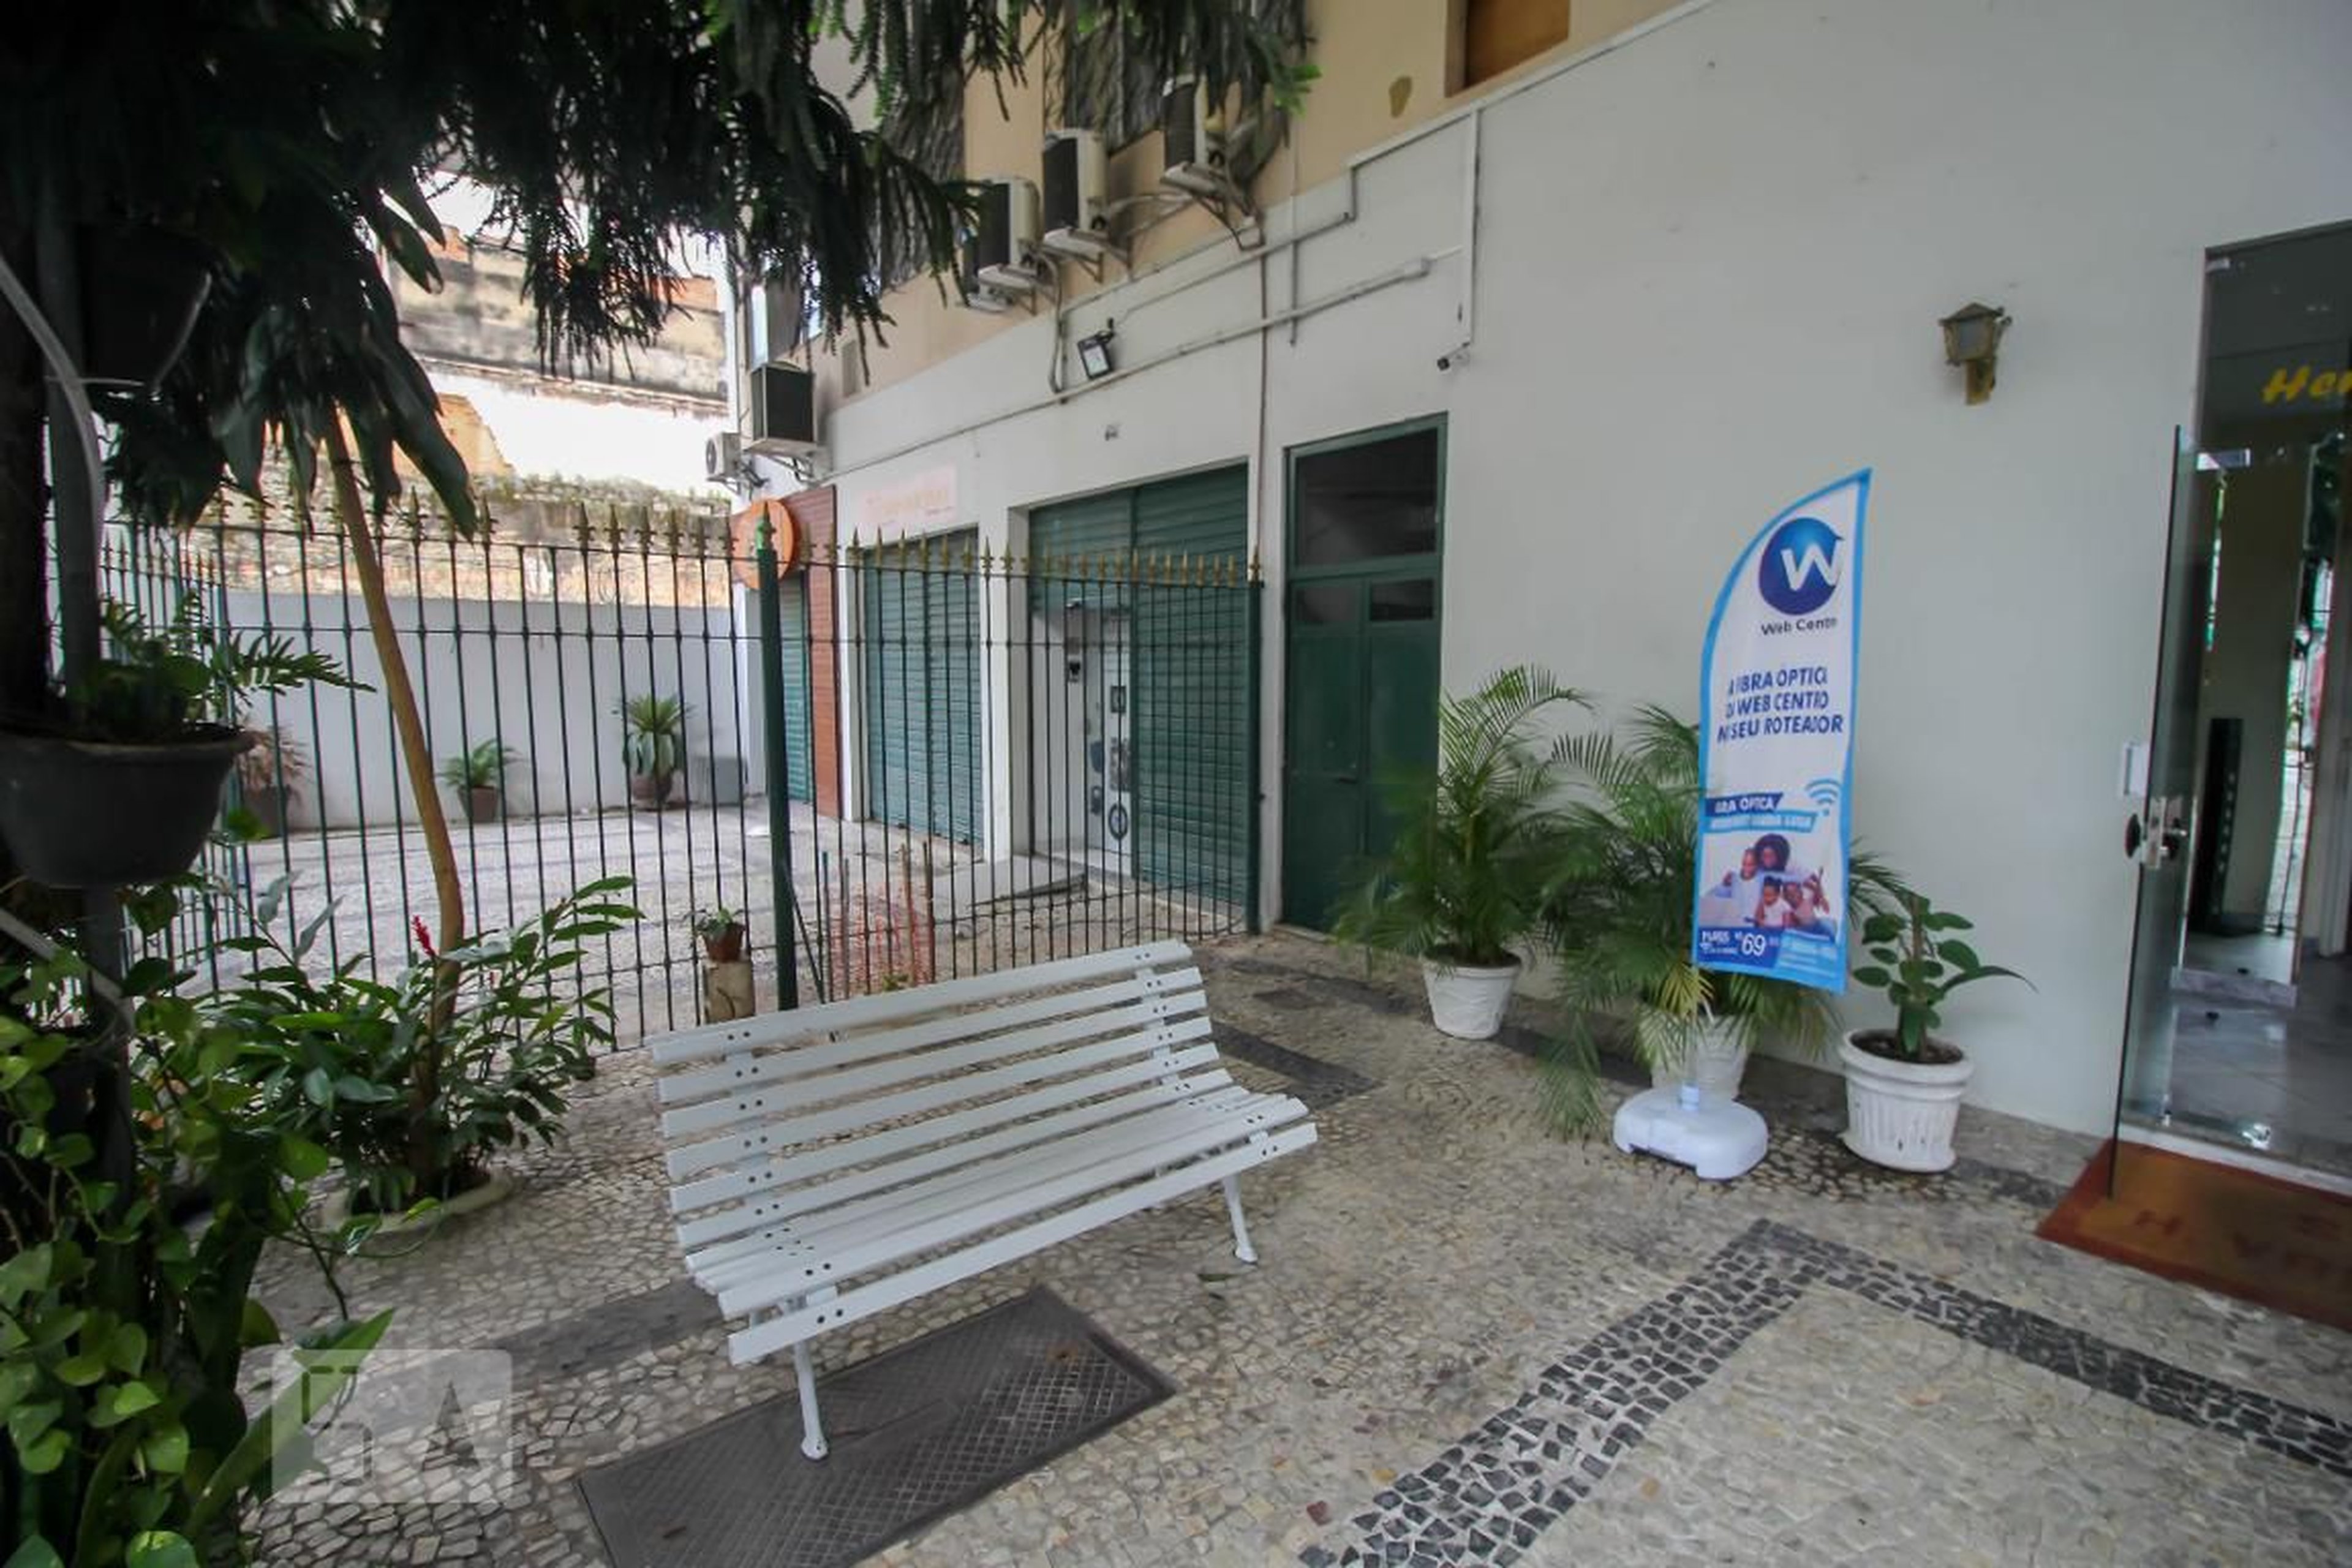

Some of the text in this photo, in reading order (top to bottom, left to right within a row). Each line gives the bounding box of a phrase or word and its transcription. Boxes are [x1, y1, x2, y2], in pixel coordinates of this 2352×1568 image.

[1735, 671, 1773, 694] BRA
[1737, 694, 1771, 716] WEB
[1730, 718, 1760, 741] SEU
[1741, 933, 1766, 956] 69
